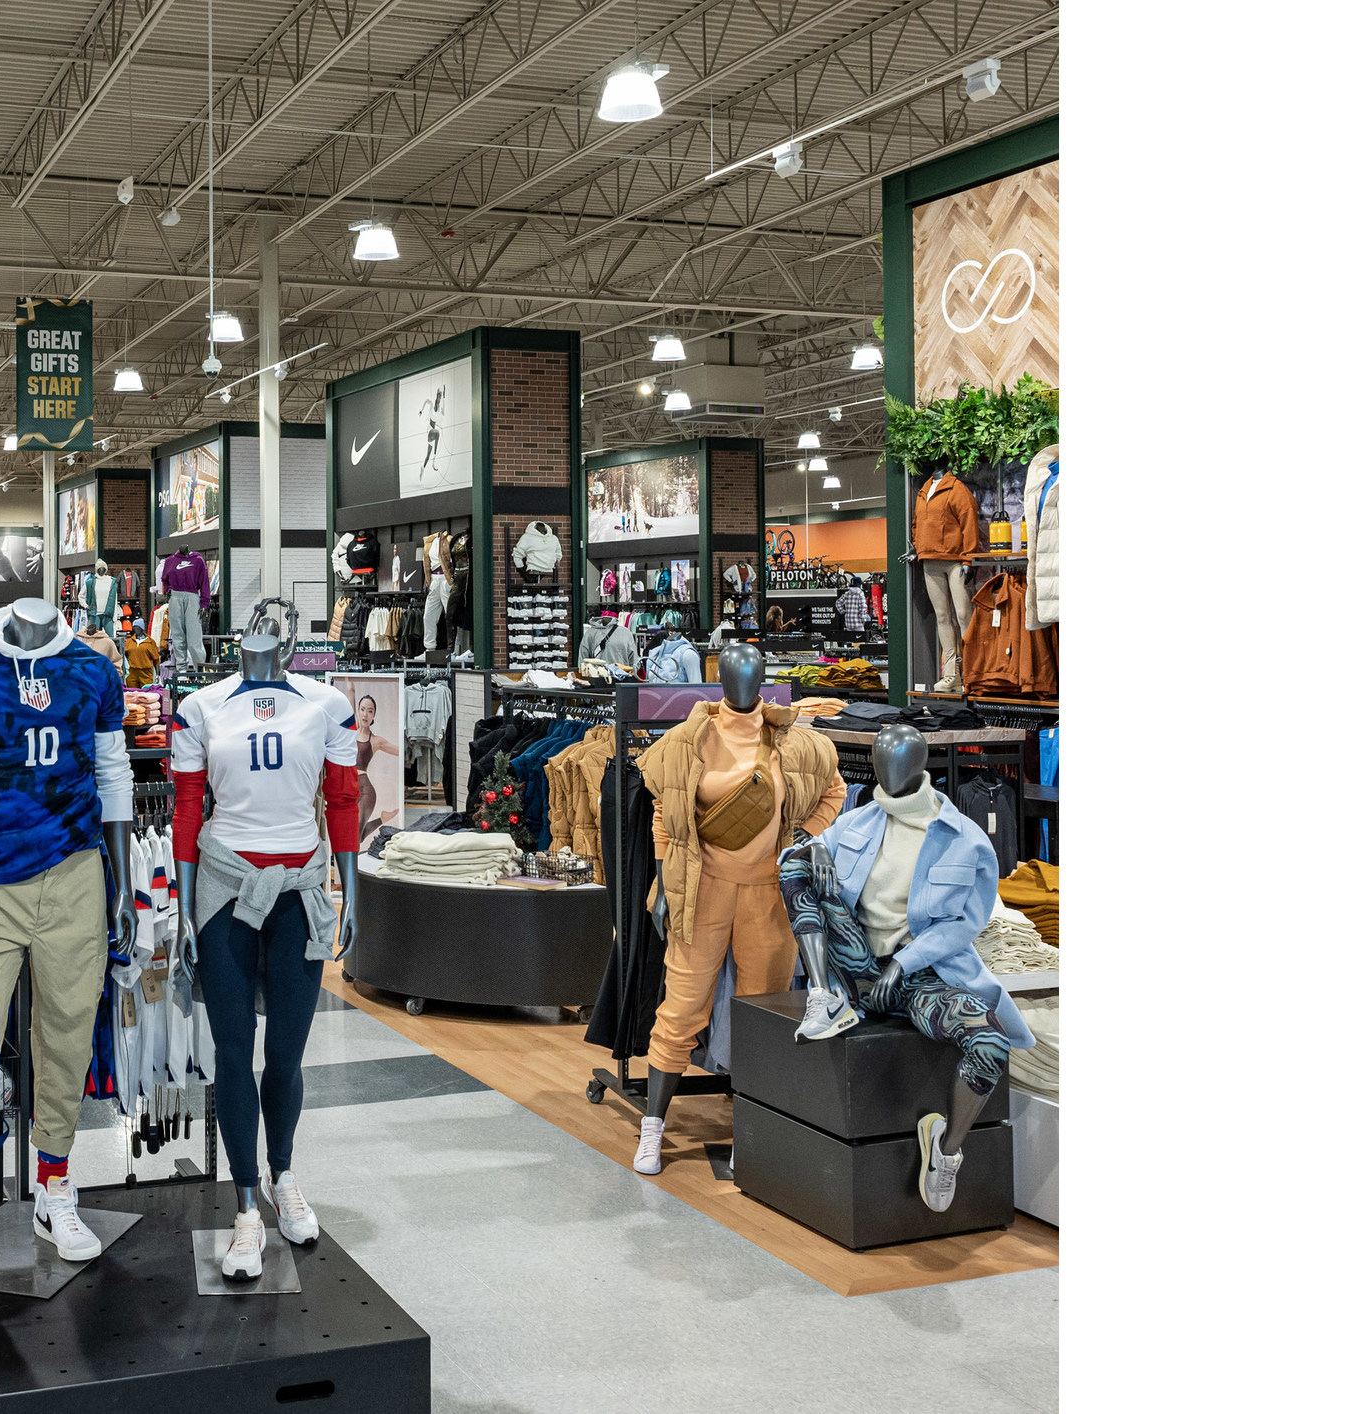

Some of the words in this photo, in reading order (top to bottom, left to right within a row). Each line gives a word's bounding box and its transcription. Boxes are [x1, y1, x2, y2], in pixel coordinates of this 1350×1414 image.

[27, 329, 83, 350] GREAT
[30, 352, 79, 374] GIFTS
[27, 375, 83, 396] START
[33, 399, 77, 420] HERE
[770, 569, 814, 582] PELOTON
[302, 657, 328, 666] CALIA
[23, 679, 47, 694] USA
[255, 700, 273, 709] USA
[24, 726, 60, 767] 10
[247, 732, 283, 771] 10
